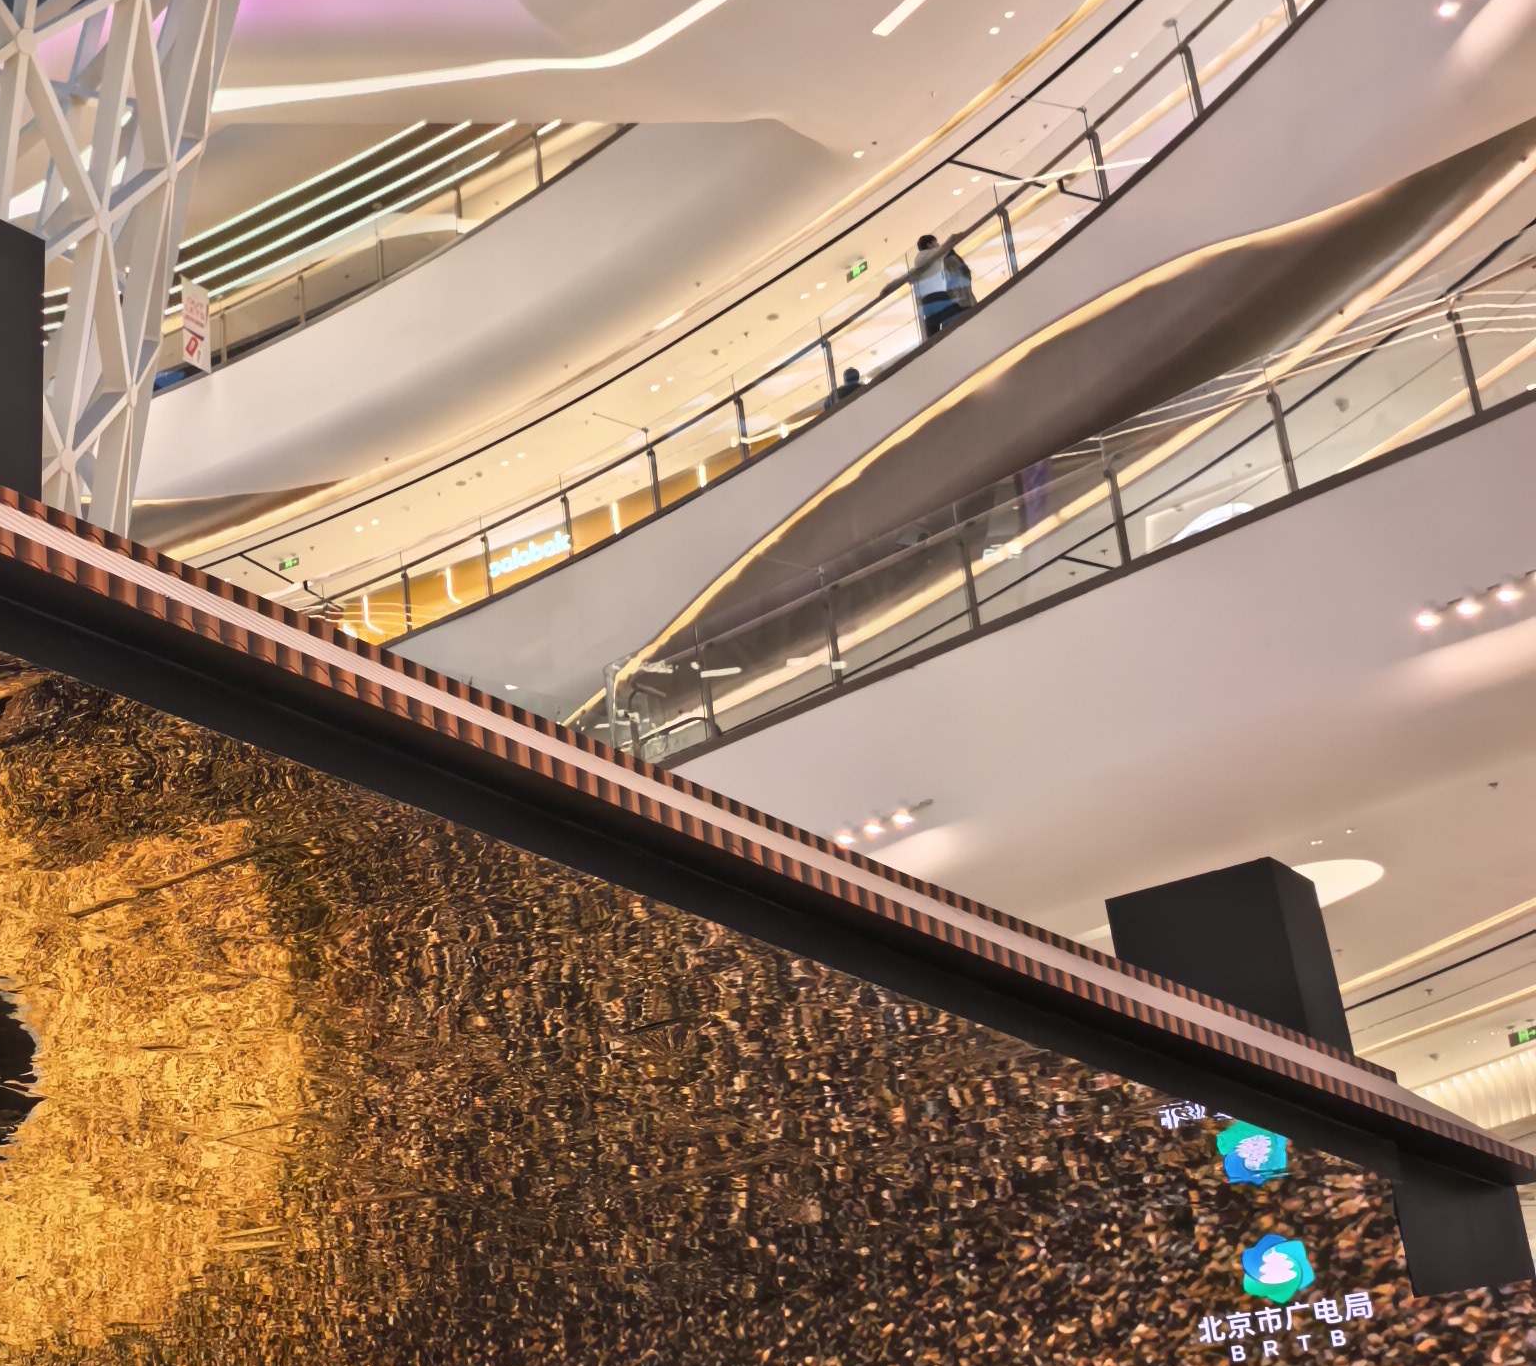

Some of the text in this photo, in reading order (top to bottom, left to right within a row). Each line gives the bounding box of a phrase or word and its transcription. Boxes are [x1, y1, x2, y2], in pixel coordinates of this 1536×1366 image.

[1198, 1291, 1373, 1344] 北京市广电局
